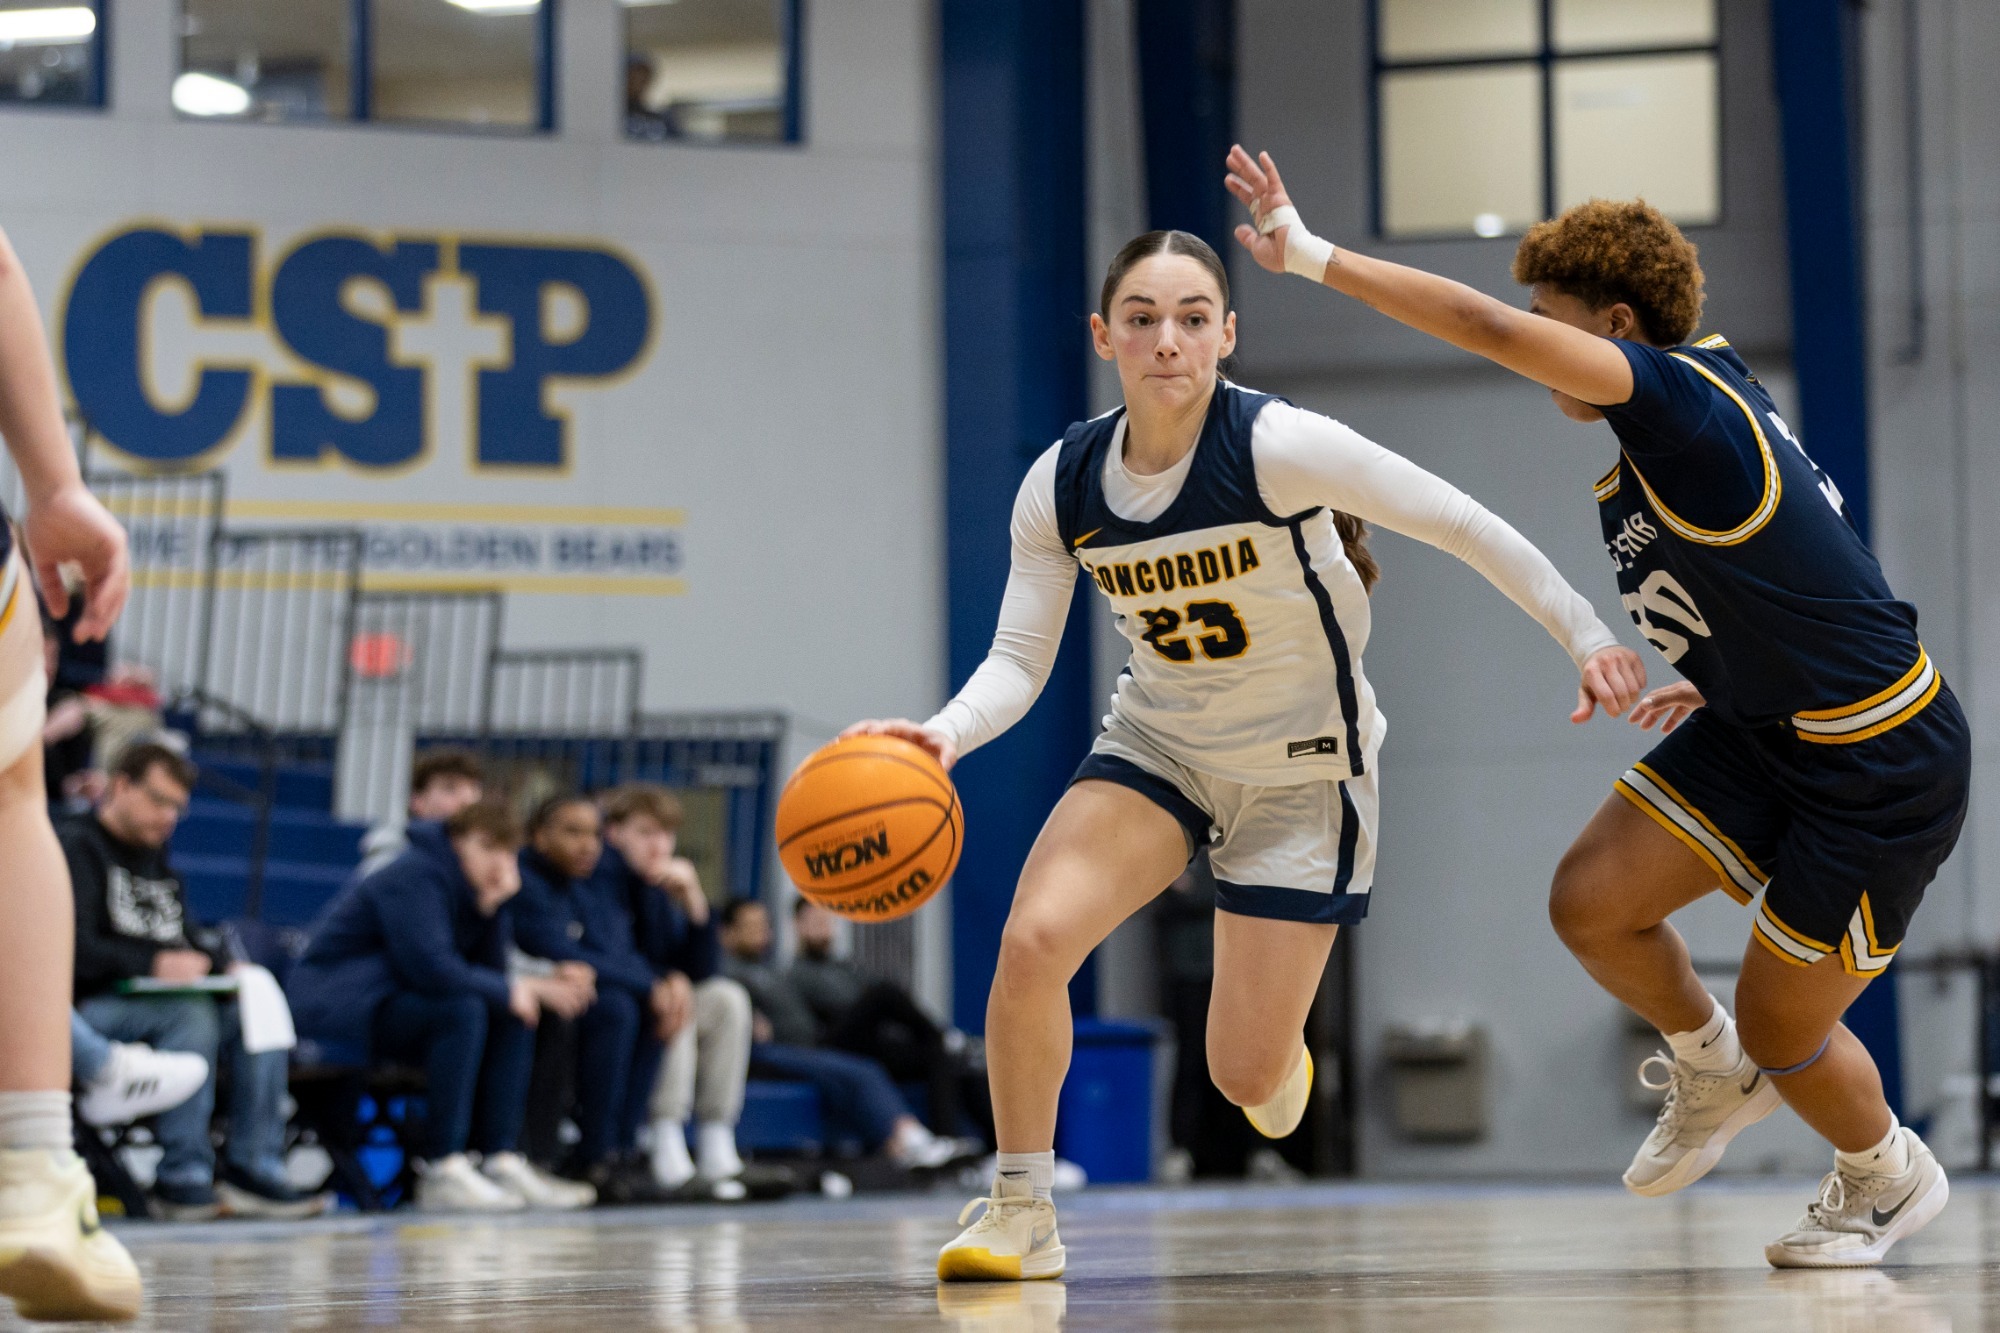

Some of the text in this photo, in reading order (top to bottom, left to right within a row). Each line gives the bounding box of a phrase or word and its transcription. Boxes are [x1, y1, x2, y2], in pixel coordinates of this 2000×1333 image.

[59, 219, 662, 474] CSP
[550, 529, 684, 573] BEARS
[1136, 598, 1252, 664] 23
[804, 829, 891, 880] NCAA
